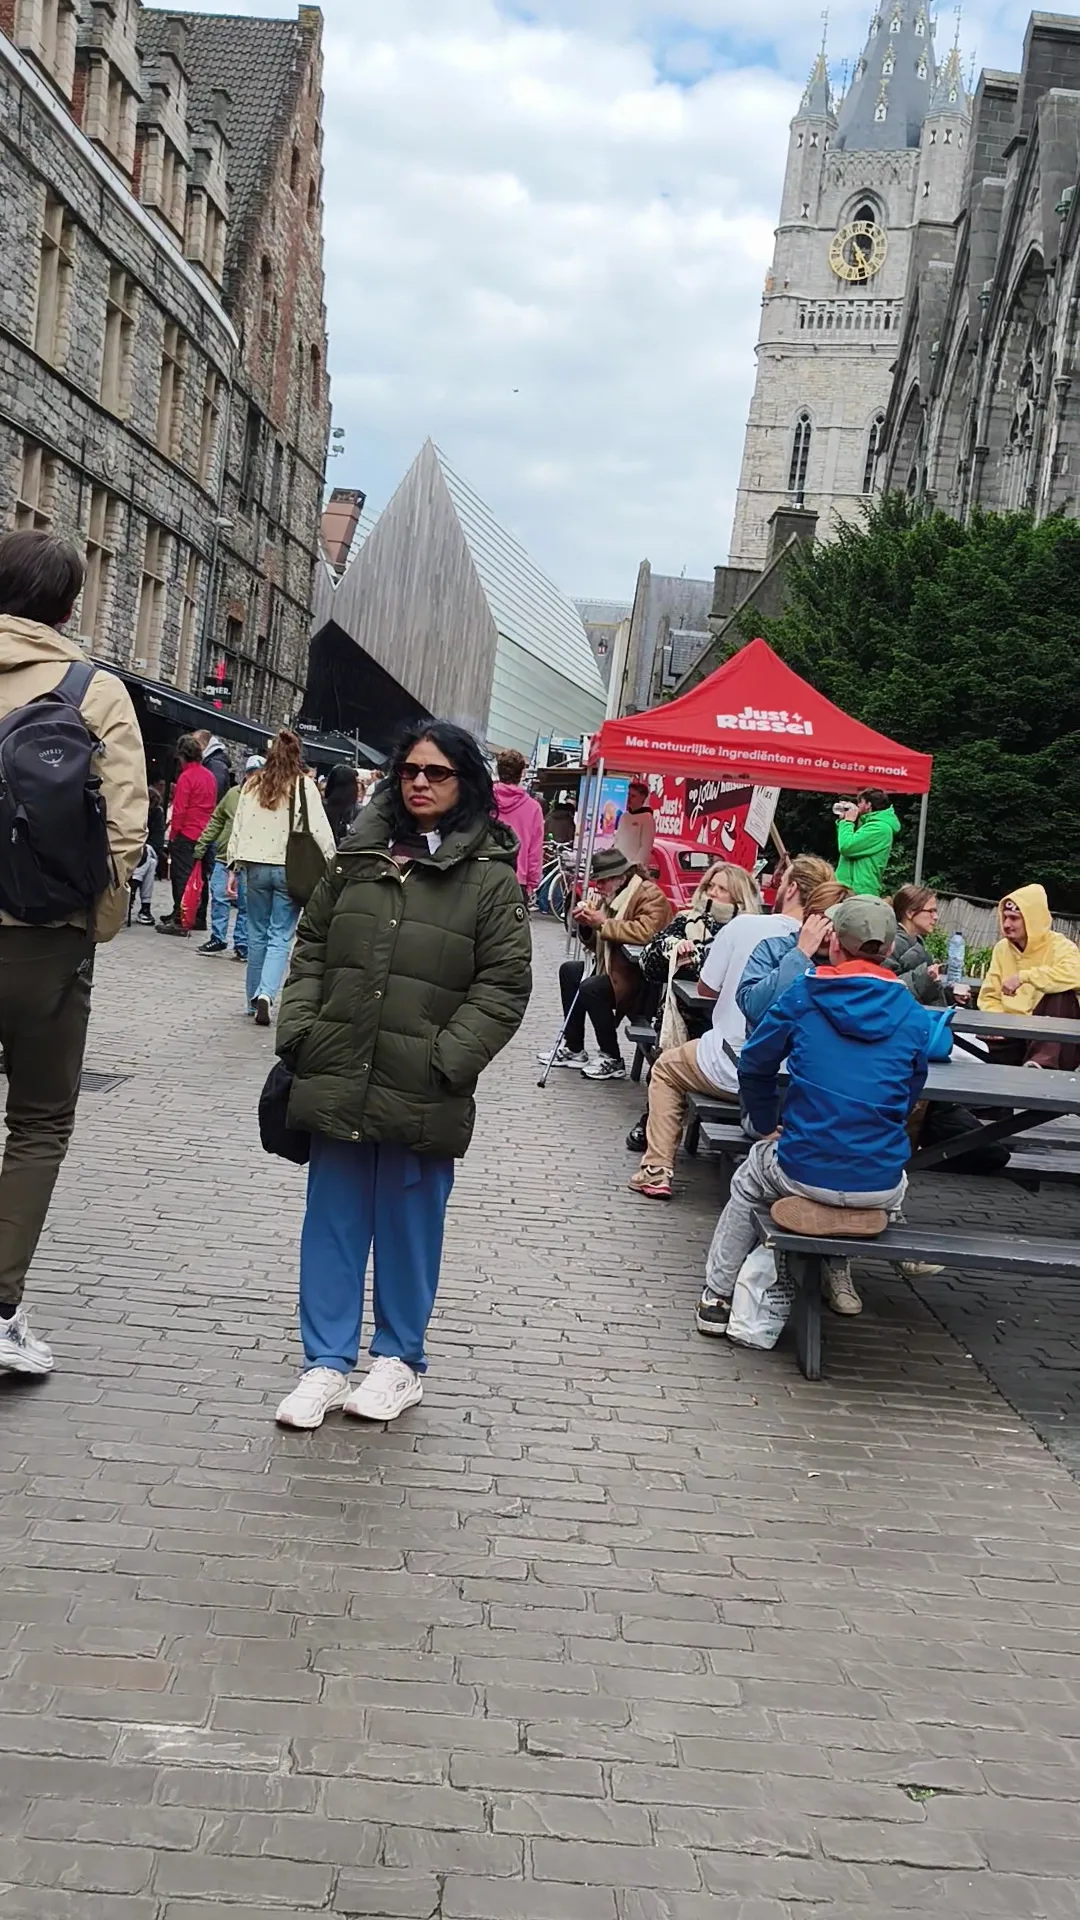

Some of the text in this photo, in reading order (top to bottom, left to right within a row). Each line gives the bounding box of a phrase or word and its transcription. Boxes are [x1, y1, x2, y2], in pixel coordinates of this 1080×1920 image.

[738, 706, 789, 722] Just
[716, 714, 814, 736] Russel
[625, 735, 908, 777] Met natuurlijke ingrediënten en de beste smaak
[660, 794, 678, 815] Just
[689, 789, 698, 803] op
